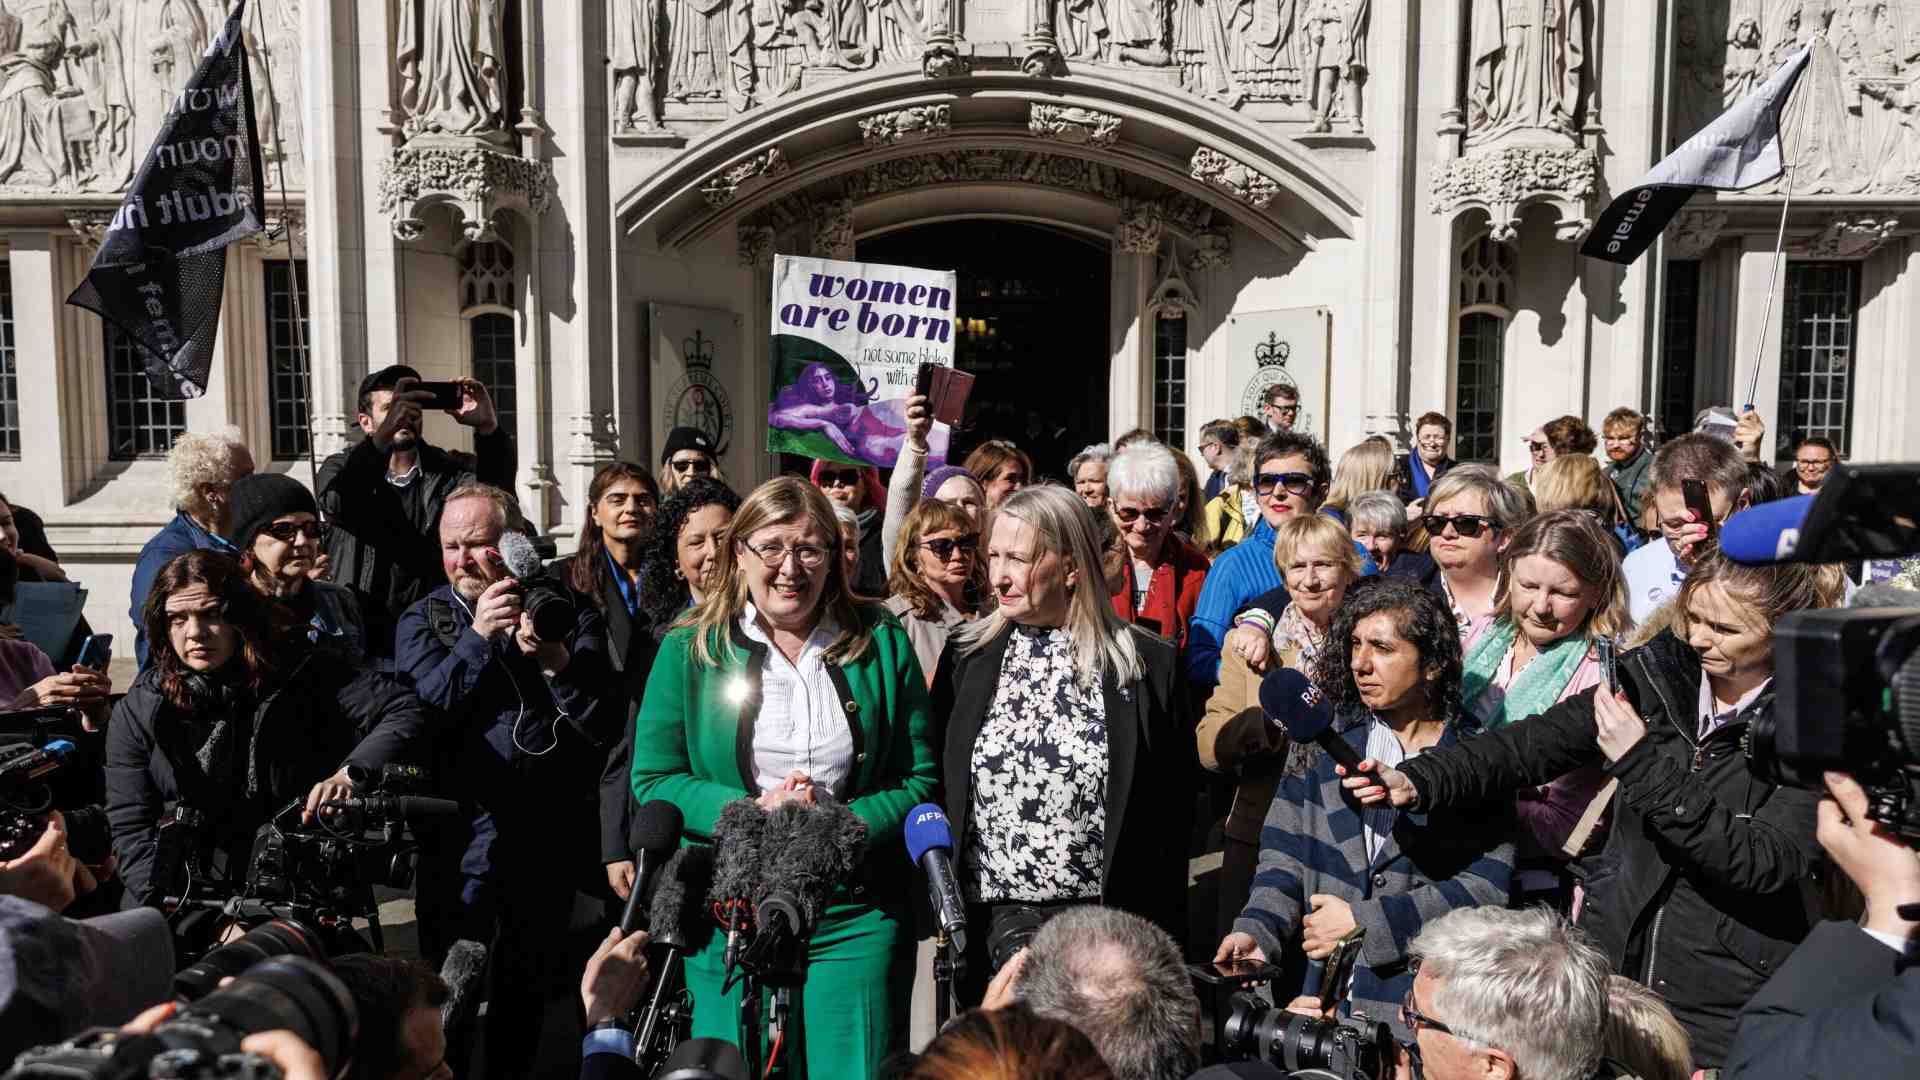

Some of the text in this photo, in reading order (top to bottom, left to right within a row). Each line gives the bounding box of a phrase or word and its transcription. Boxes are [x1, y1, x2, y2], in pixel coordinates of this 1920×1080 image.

[1607, 188, 1653, 253] emale
[809, 273, 951, 311] women
[780, 302, 951, 344] are born
[863, 347, 882, 362] not
[884, 350, 916, 365] some
[886, 367, 908, 386] with
[916, 811, 942, 825] AFP
